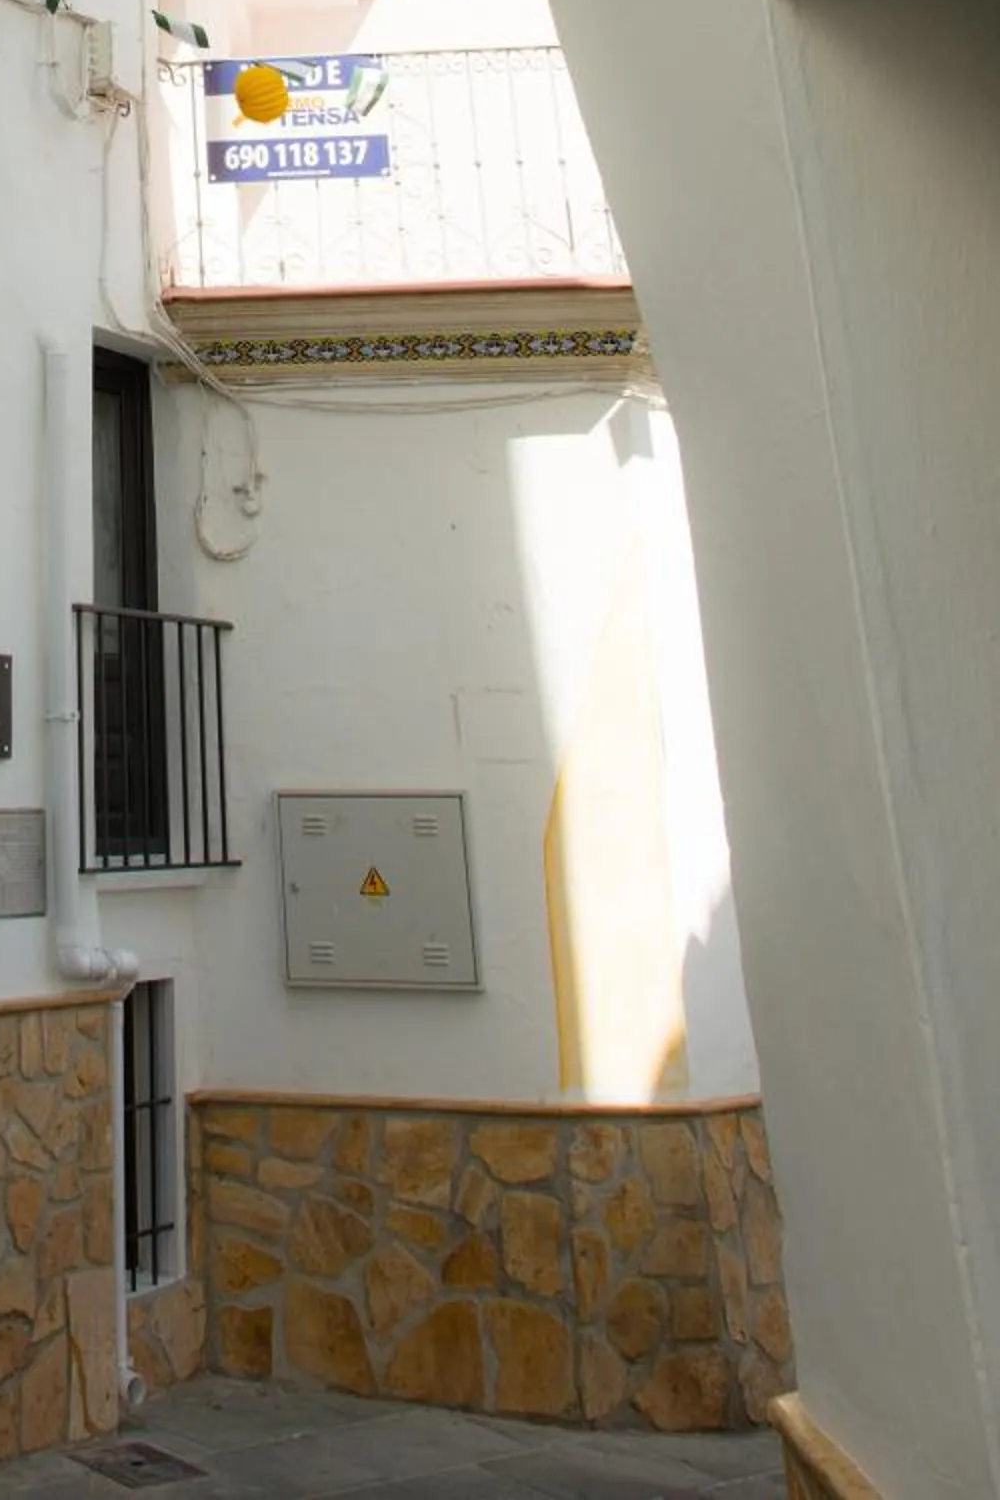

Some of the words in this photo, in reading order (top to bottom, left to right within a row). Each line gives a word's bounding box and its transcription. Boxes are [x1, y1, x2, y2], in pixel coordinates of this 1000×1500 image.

[224, 144, 269, 171] 690
[273, 141, 319, 168] 118
[323, 139, 368, 166] 137
